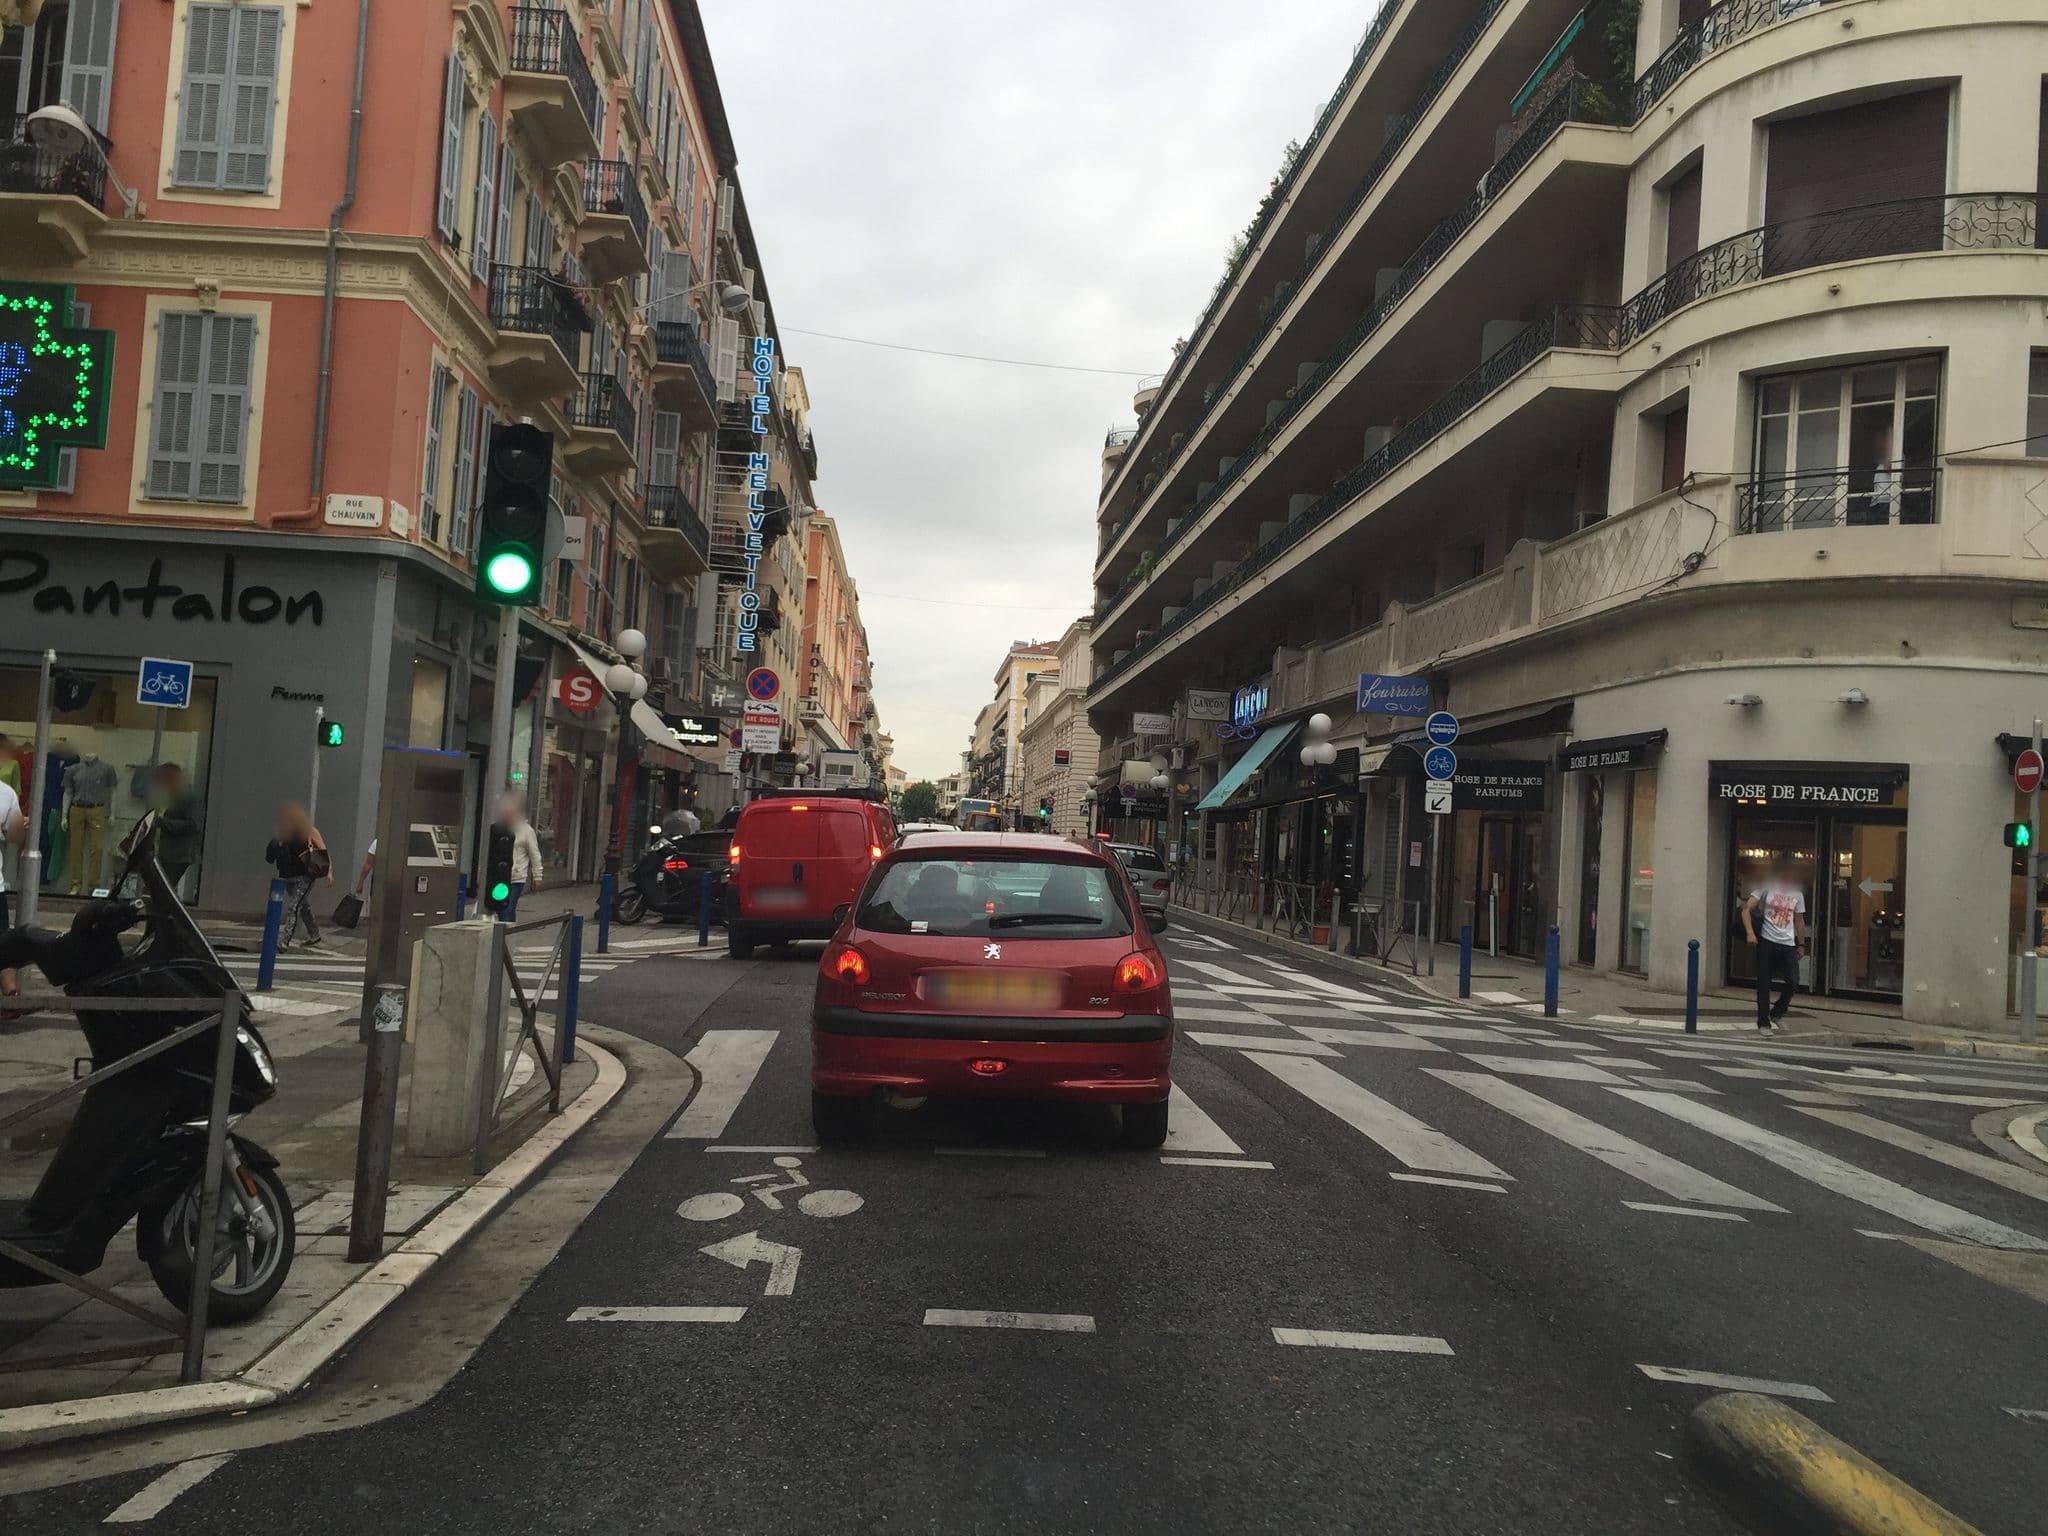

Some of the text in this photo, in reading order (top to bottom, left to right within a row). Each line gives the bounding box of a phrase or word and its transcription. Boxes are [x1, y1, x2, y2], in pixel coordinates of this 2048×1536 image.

[737, 336, 774, 651] HOTEL HELVETIQUE
[346, 499, 364, 507] RUE
[331, 510, 376, 521] CHAUVAIN
[807, 643, 821, 711] HOTEL
[569, 676, 593, 702] S
[1361, 677, 1429, 708] fourrures
[1384, 702, 1427, 713] GUY
[1570, 751, 1630, 769] ROSE DE FRANCE
[1454, 774, 1543, 786] ROSE DE FRANCE
[1475, 787, 1523, 798] PARFUMS
[1720, 784, 1879, 802] ROSE DE FRANCE
